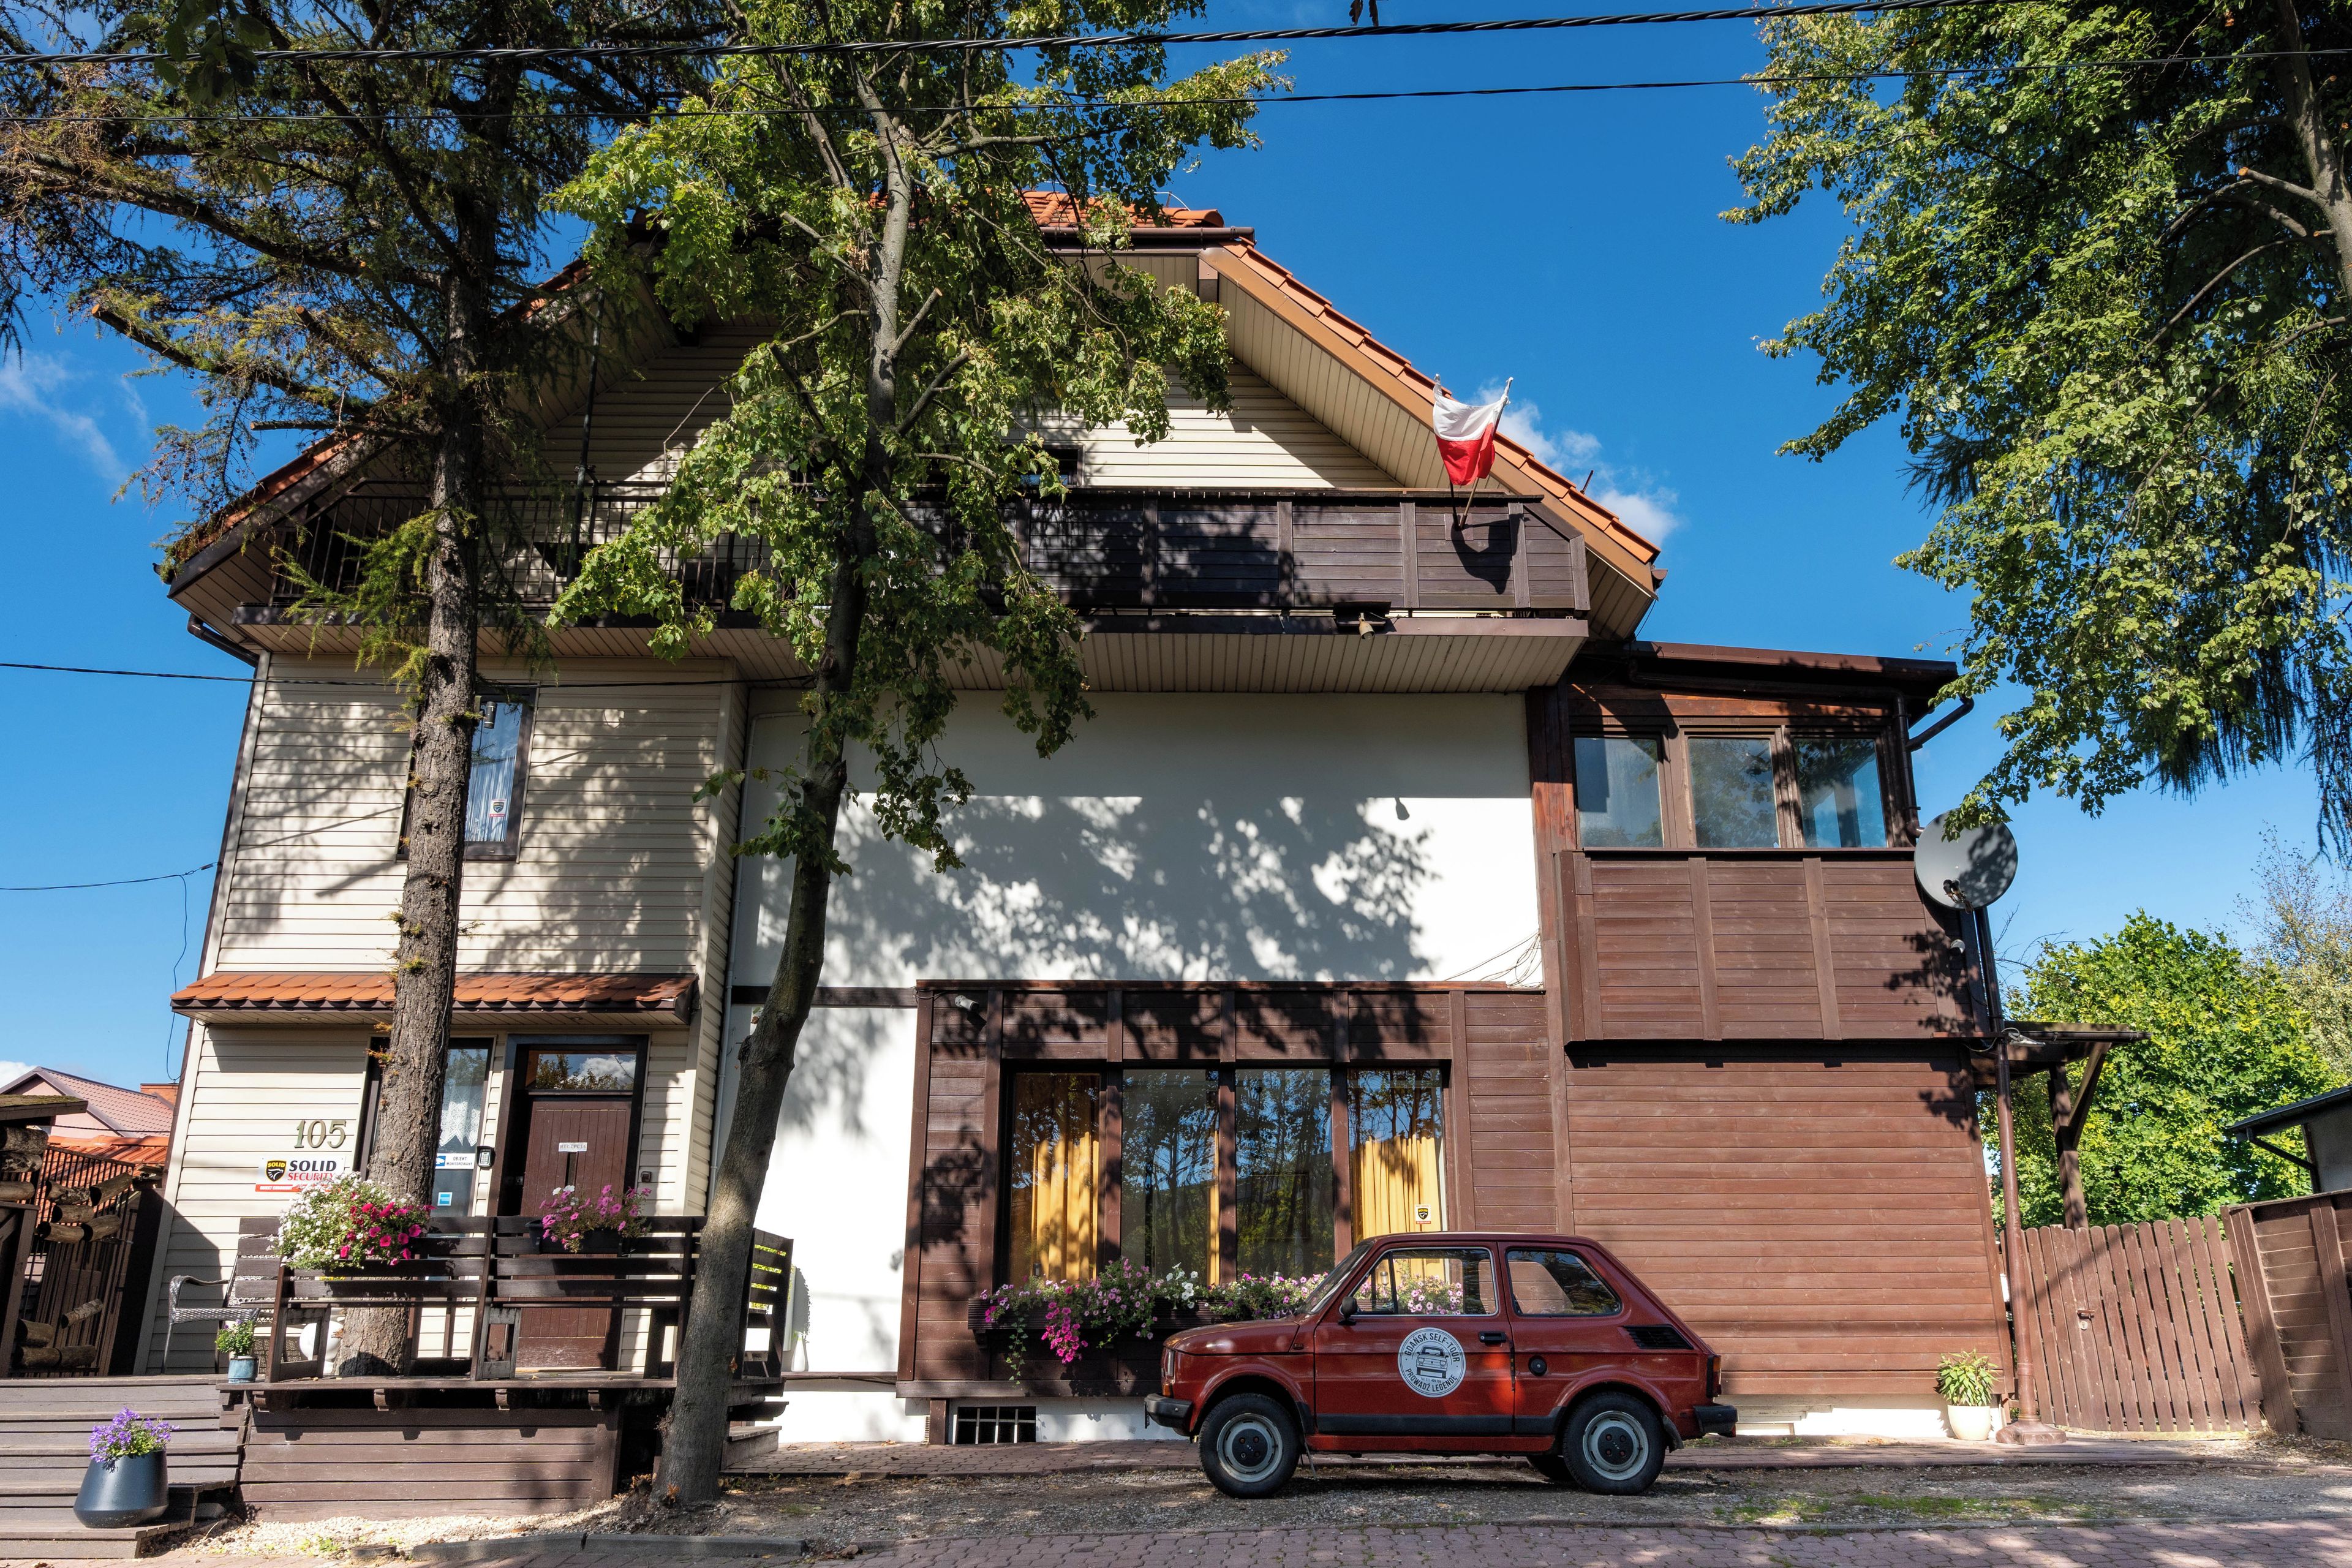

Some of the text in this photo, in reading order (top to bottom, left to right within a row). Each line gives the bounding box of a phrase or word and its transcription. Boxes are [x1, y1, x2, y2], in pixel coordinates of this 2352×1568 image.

[294, 1120, 346, 1148] 105
[289, 1160, 337, 1172] SOLID
[1404, 1332, 1460, 1362] GDAŃSK SELF-TOUR
[1405, 1368, 1458, 1392] PROWADŹ LEGENDĘ
